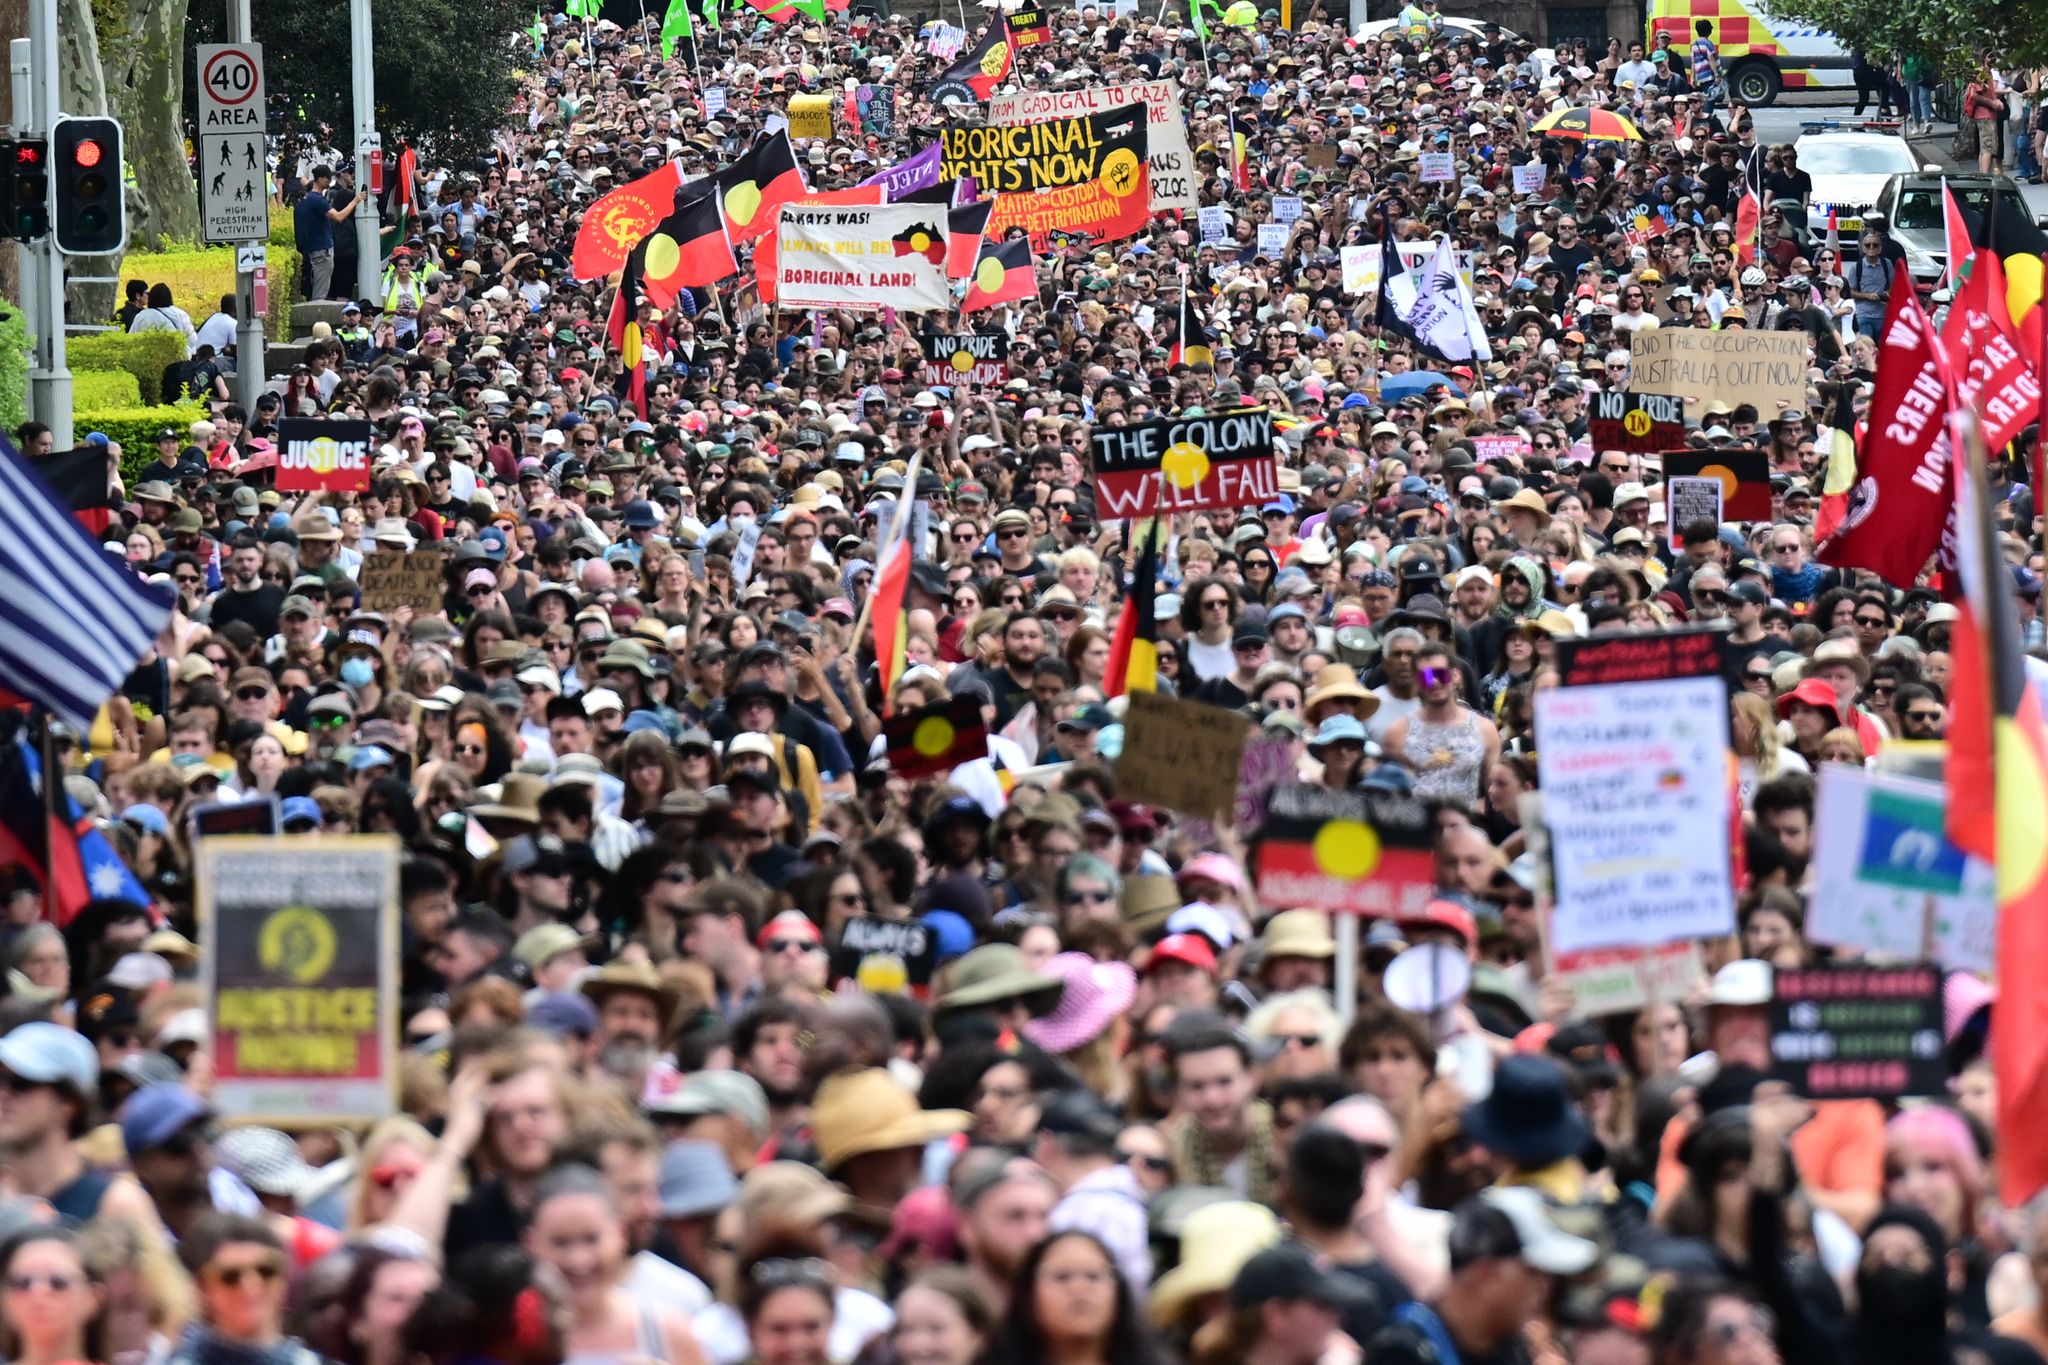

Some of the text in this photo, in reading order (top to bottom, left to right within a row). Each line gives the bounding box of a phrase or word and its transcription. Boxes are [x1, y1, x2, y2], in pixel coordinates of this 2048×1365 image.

[1010, 13, 1037, 26] TREATY
[1016, 32, 1040, 45] TRUTH
[211, 64, 251, 91] 40
[870, 100, 889, 110] STILL
[992, 85, 1171, 117] FROM GADIGAL TO GAZA
[207, 108, 258, 125] AREA
[869, 110, 889, 119] HERE
[940, 117, 1103, 159] ABORIGINAL
[938, 147, 1097, 191] RIGHTS NOW
[1149, 152, 1181, 173] AWS
[994, 181, 1101, 214] DEATHS IN CUSTODY
[1151, 177, 1188, 199] RZOG
[210, 216, 262, 225] PEDESTRIAN
[225, 206, 246, 214] HIGH
[836, 212, 870, 225] WAS!
[1615, 203, 1649, 226] LAND
[216, 225, 256, 234] ACTIVITY
[1622, 223, 1635, 238] IS
[1625, 225, 1658, 246] LIFE
[783, 239, 830, 254] LWAYS
[835, 241, 864, 255] WILL
[783, 269, 917, 287] BORIGINAL LAND!
[934, 336, 998, 358] NO PRIDE
[1633, 333, 1804, 357] END THE OCCUPATION
[926, 363, 1006, 386] IN GENOCIDE
[1632, 359, 1802, 386] AUSTRALIA OUT NOW
[1600, 393, 1682, 423] NO PRIDE
[1630, 414, 1646, 432] IN
[1092, 414, 1272, 463] THE COLONY
[280, 440, 367, 469] JUSTICE
[1098, 460, 1281, 515] WILL FALL
[842, 918, 927, 957] ALWAYS
